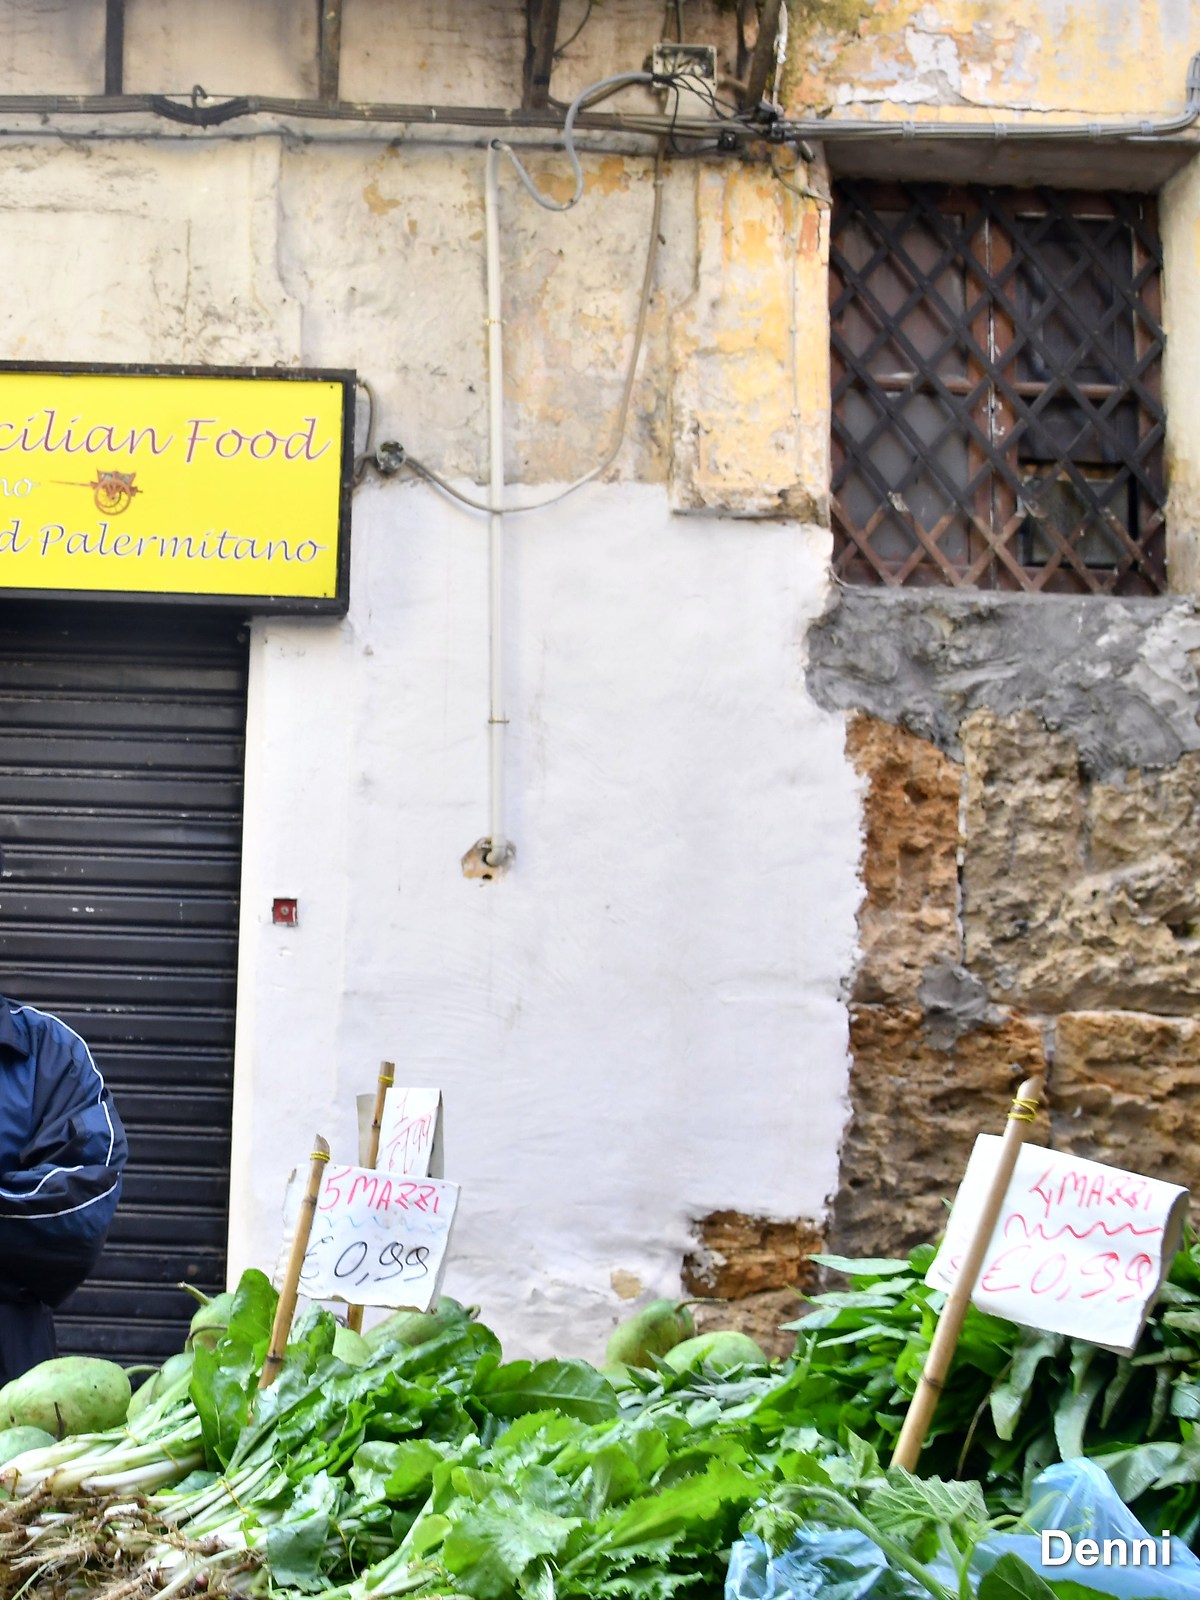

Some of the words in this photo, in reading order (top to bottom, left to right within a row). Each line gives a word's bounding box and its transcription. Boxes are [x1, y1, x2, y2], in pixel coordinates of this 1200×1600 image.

[186, 417, 331, 463] Food
[40, 522, 329, 565] Palermitano
[319, 1168, 352, 1211] 5
